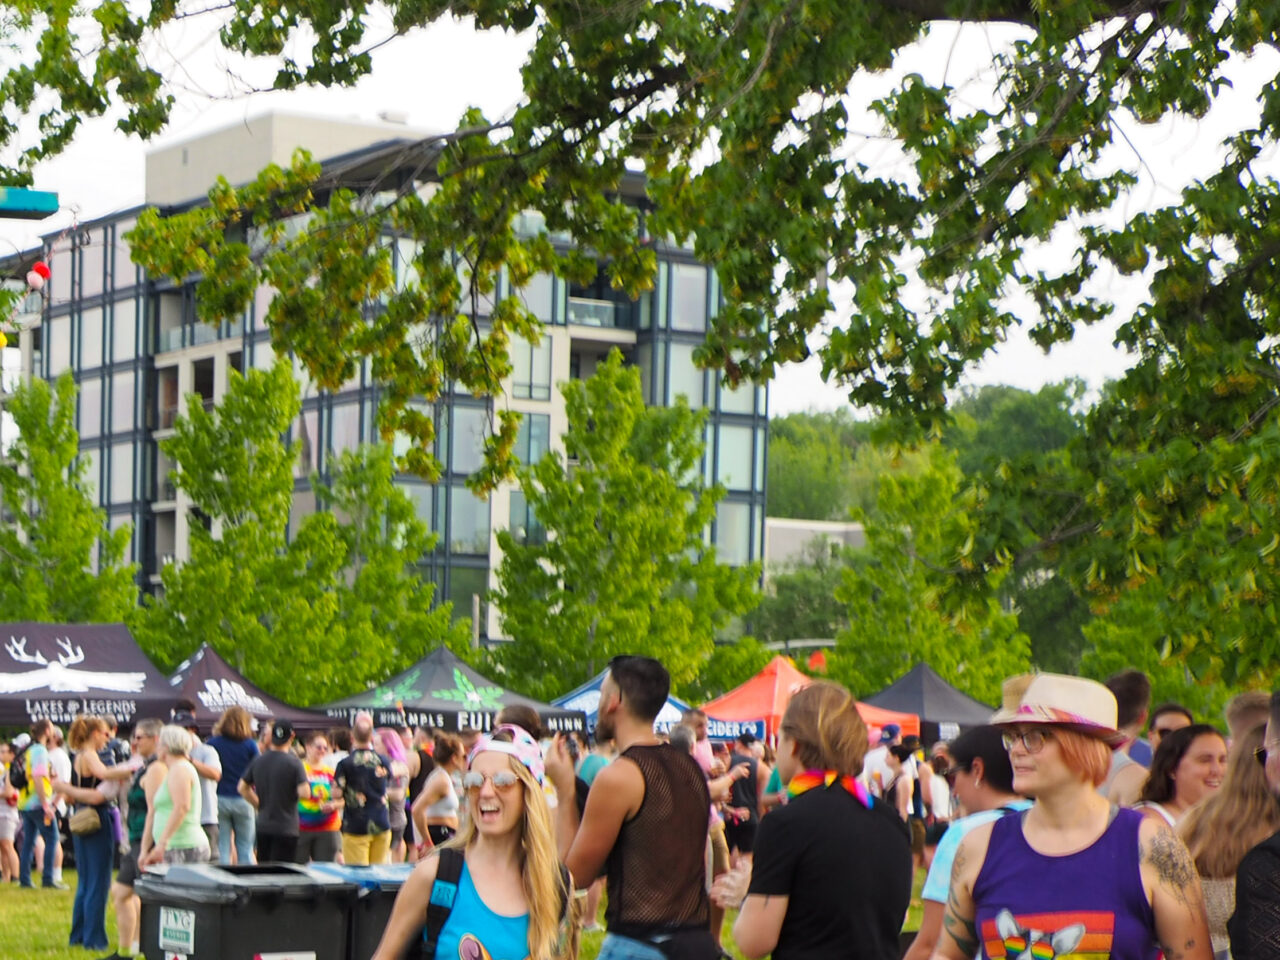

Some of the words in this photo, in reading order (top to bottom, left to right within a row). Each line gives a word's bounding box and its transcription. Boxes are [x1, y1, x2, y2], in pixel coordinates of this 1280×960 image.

[83, 698, 137, 714] LEGENDS
[408, 712, 444, 728] MPLS
[548, 717, 583, 731] MINN
